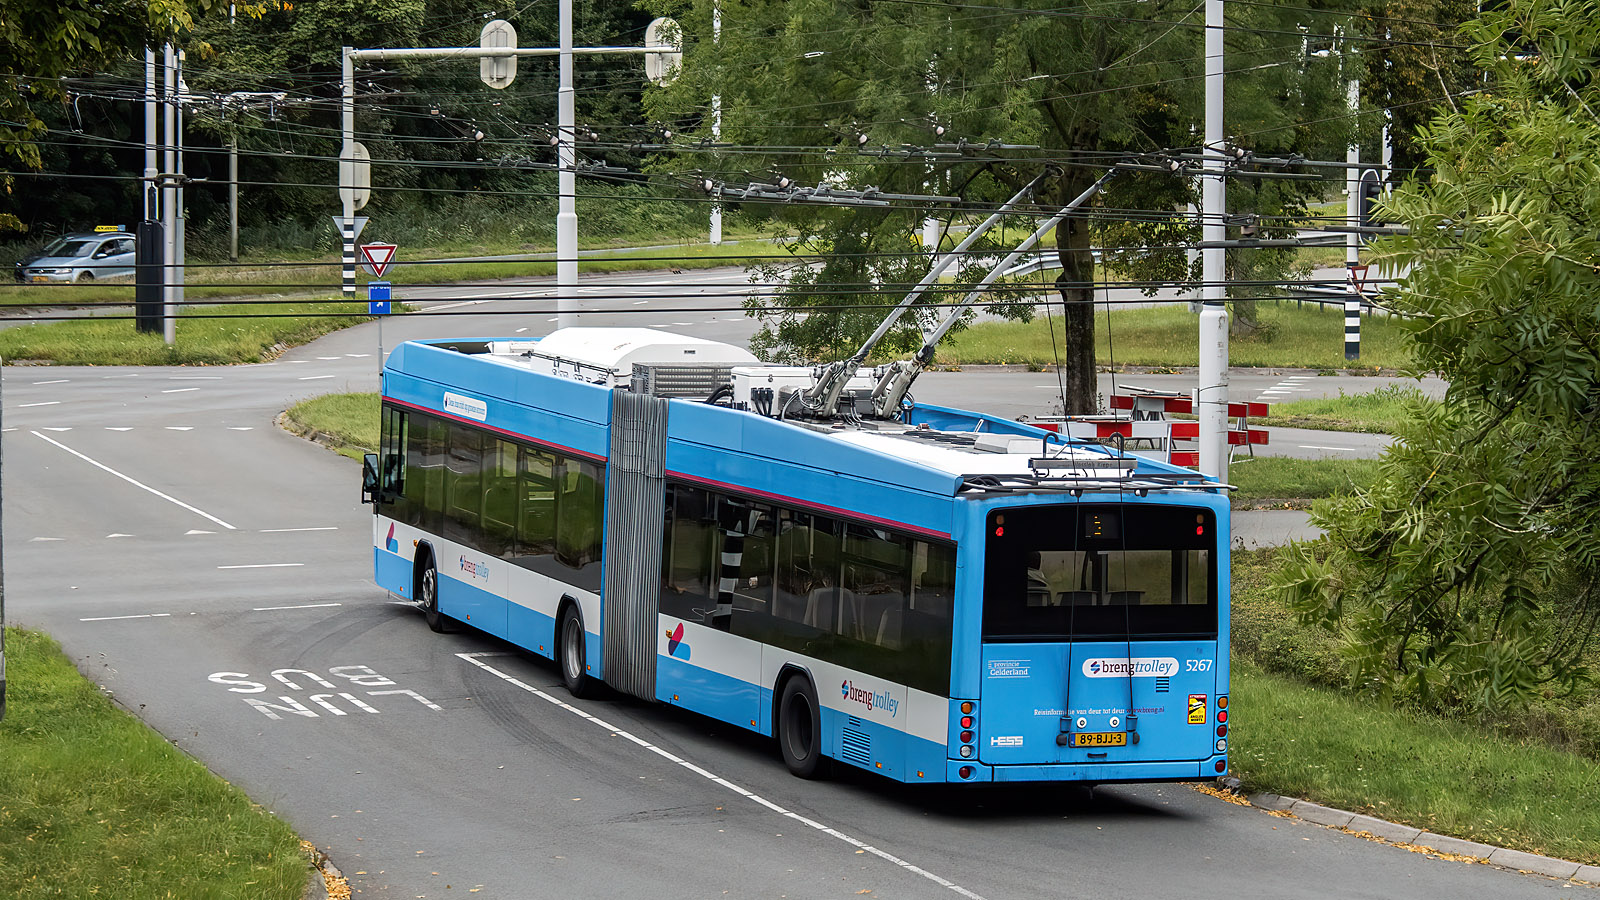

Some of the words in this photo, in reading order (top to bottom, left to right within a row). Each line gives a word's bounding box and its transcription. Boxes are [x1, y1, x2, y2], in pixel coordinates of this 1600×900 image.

[990, 668, 1029, 676] Gelderland
[1101, 659, 1173, 676] brengtrolley
[1186, 659, 1213, 672] 5267
[207, 665, 397, 693] BUS
[849, 680, 899, 718] brengtrolley
[990, 735, 1024, 746] HESS
[1080, 733, 1122, 744] 89-BJJ-3
